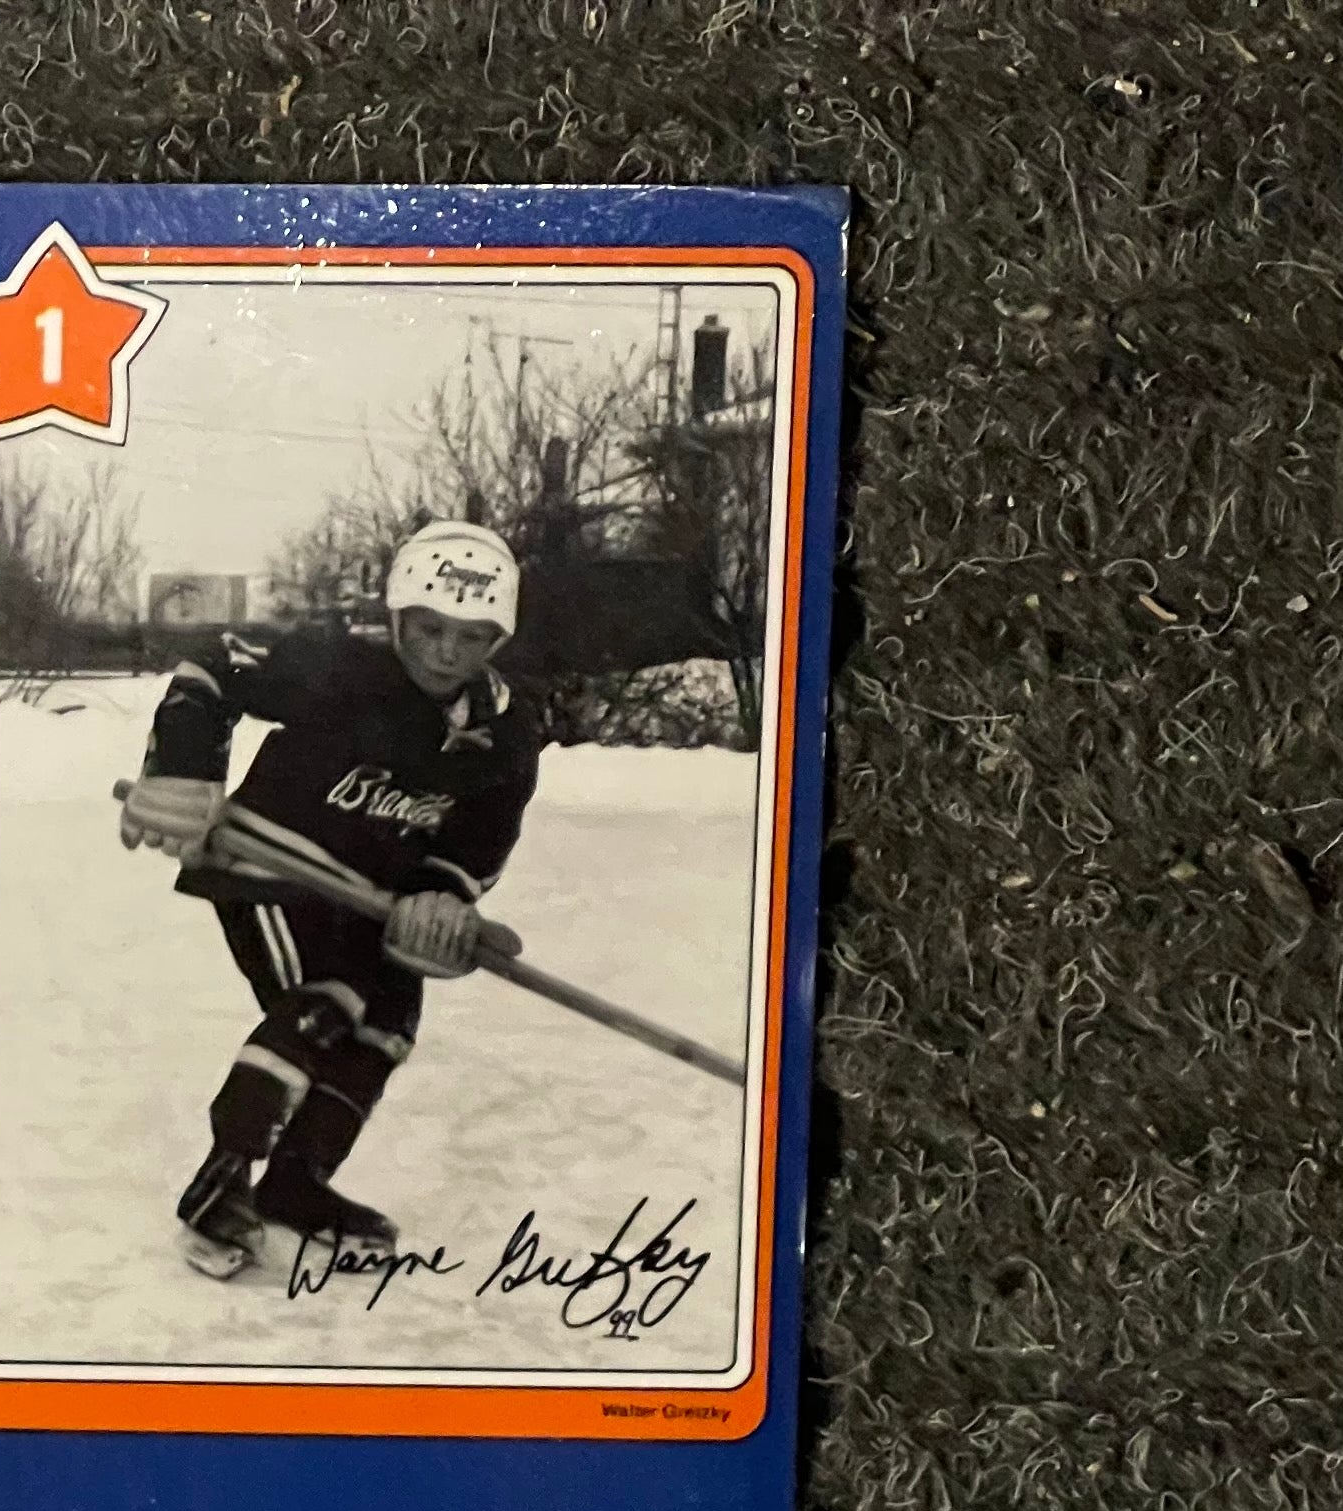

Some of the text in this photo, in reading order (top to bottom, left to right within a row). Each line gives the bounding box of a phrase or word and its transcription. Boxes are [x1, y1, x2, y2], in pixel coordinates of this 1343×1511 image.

[34, 307, 64, 385] 1
[287, 1215, 463, 1310] Wayne
[601, 1403, 732, 1423] Walter Gretzky
